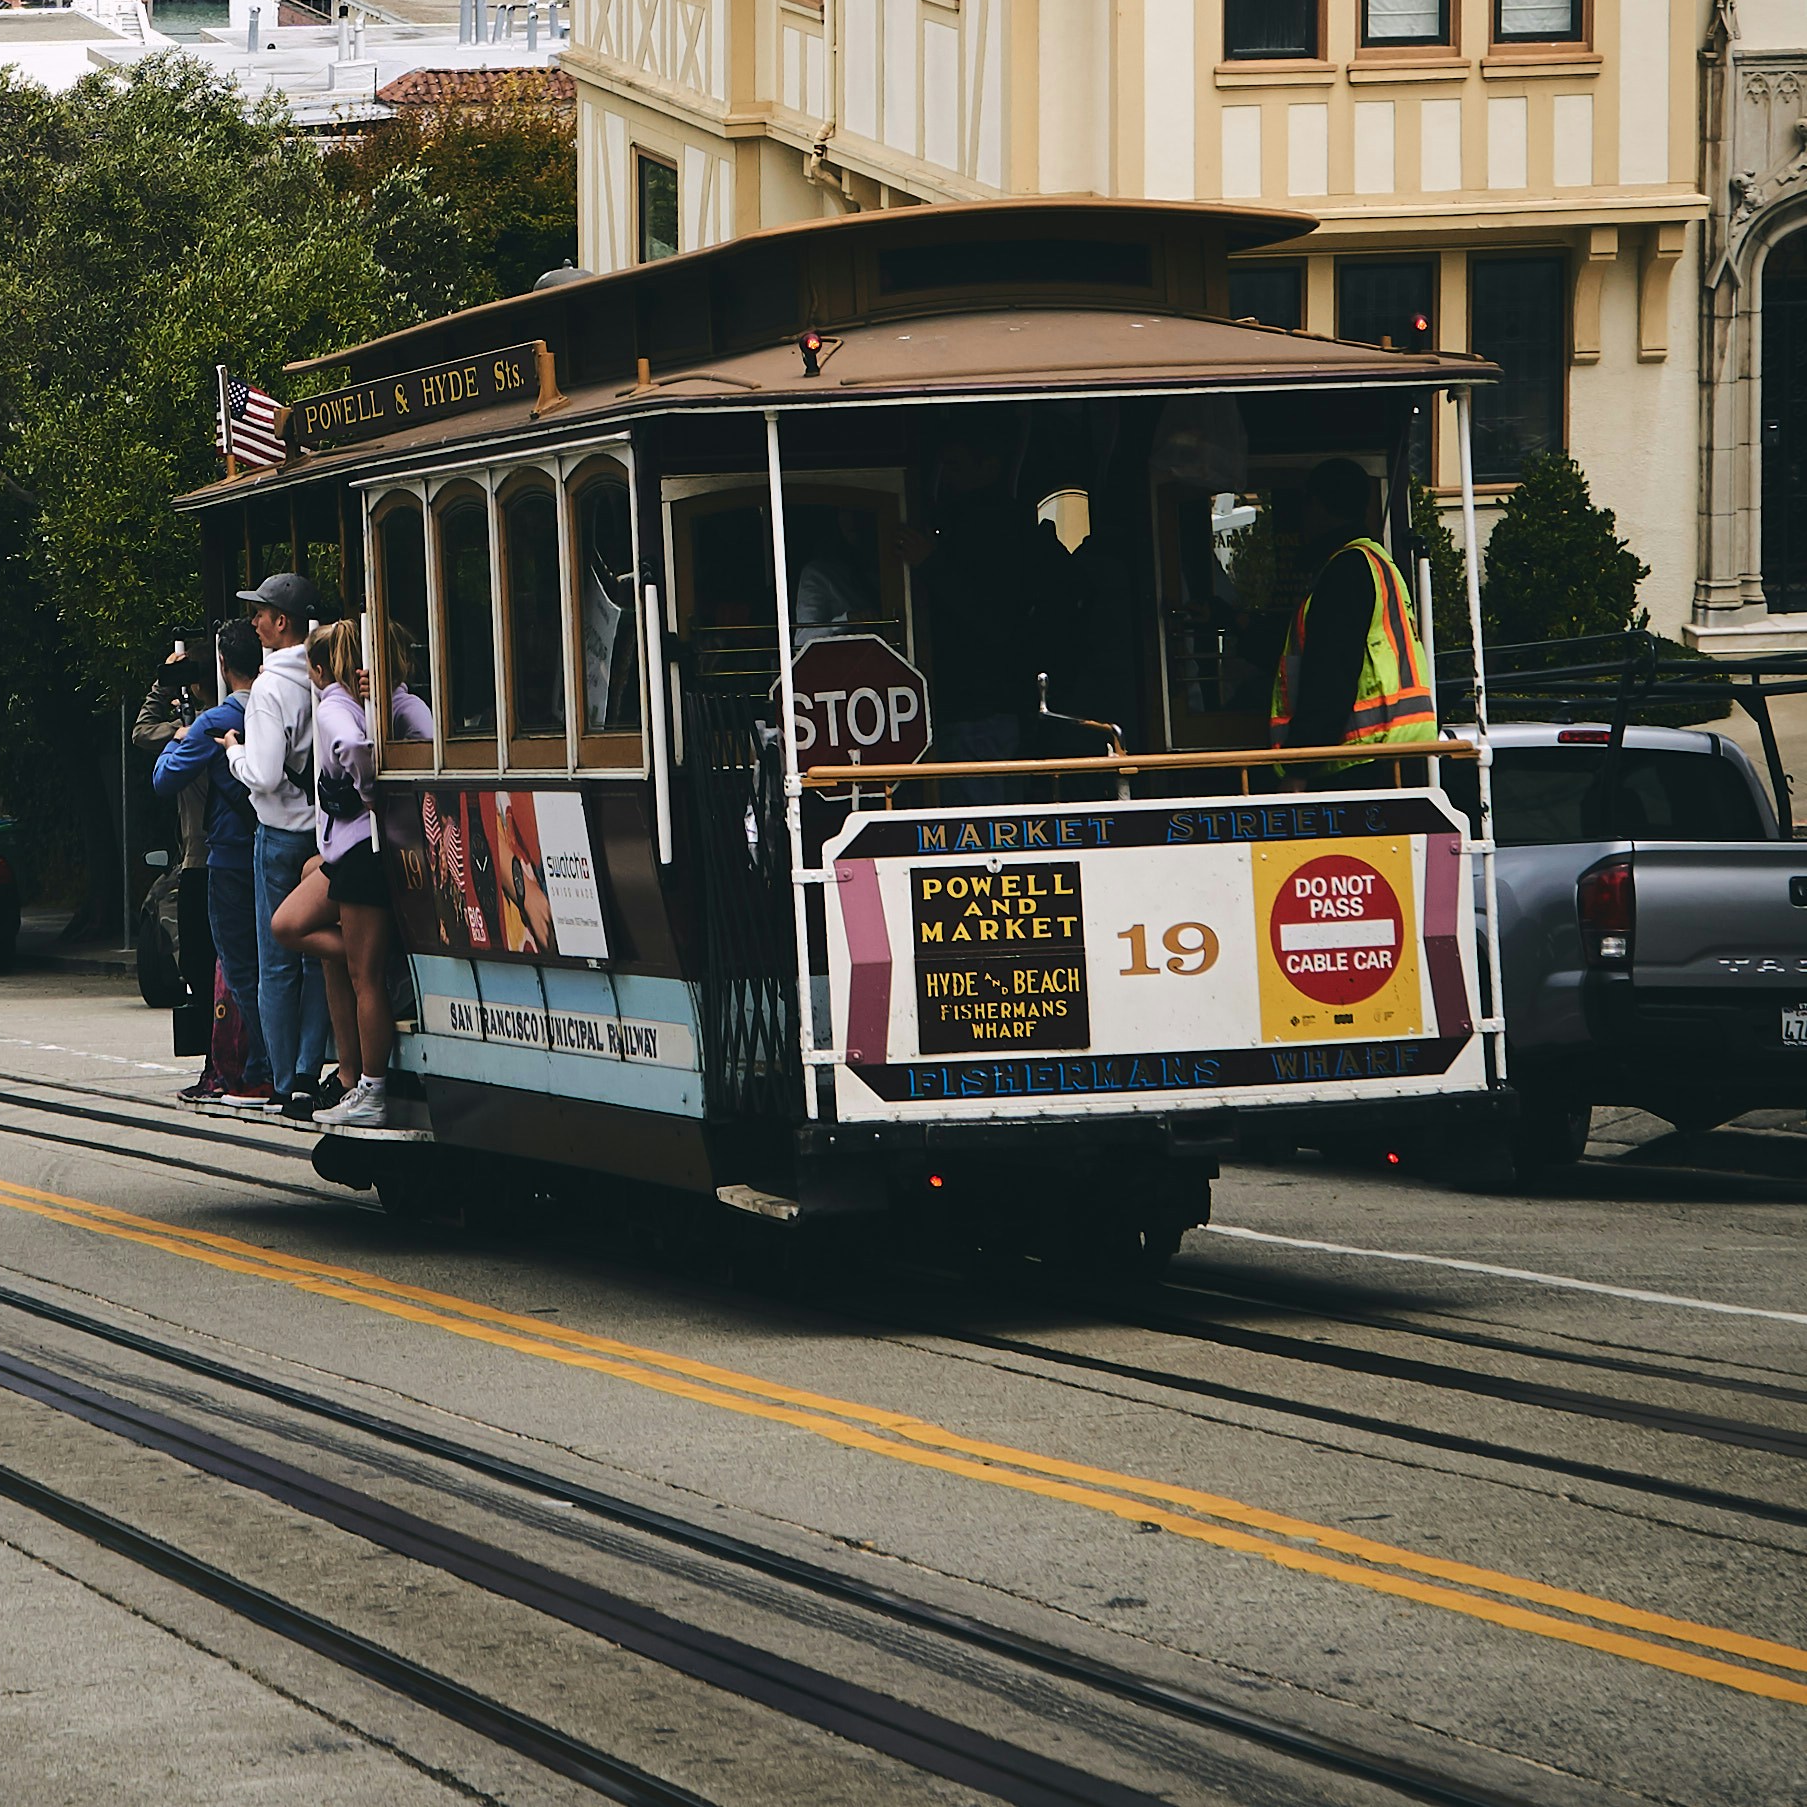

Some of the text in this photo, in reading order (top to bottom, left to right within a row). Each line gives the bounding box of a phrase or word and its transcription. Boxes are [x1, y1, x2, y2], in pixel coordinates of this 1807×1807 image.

[305, 360, 525, 434] POWELL & HYDE Sts.
[792, 686, 919, 751] STOP
[917, 817, 1116, 853] MARKET
[1167, 806, 1346, 843] STREET
[400, 848, 425, 890] 19
[546, 851, 583, 879] swatch
[551, 886, 572, 898] SWISS
[922, 874, 1074, 900] POWELL
[1295, 875, 1375, 898] DO NOT
[963, 898, 1037, 917] AND
[1310, 897, 1364, 919] PASS
[921, 916, 1078, 943] MARKET
[1117, 921, 1220, 976] 19
[1286, 950, 1393, 974] CABLE CAR
[926, 968, 1081, 998] HYDE AND BEACH
[450, 1002, 474, 1032] SAN
[940, 1000, 1068, 1021] FISHERMANS
[971, 1021, 1038, 1040] WHARF
[908, 1044, 1421, 1098] FISHERMANS WHARF
